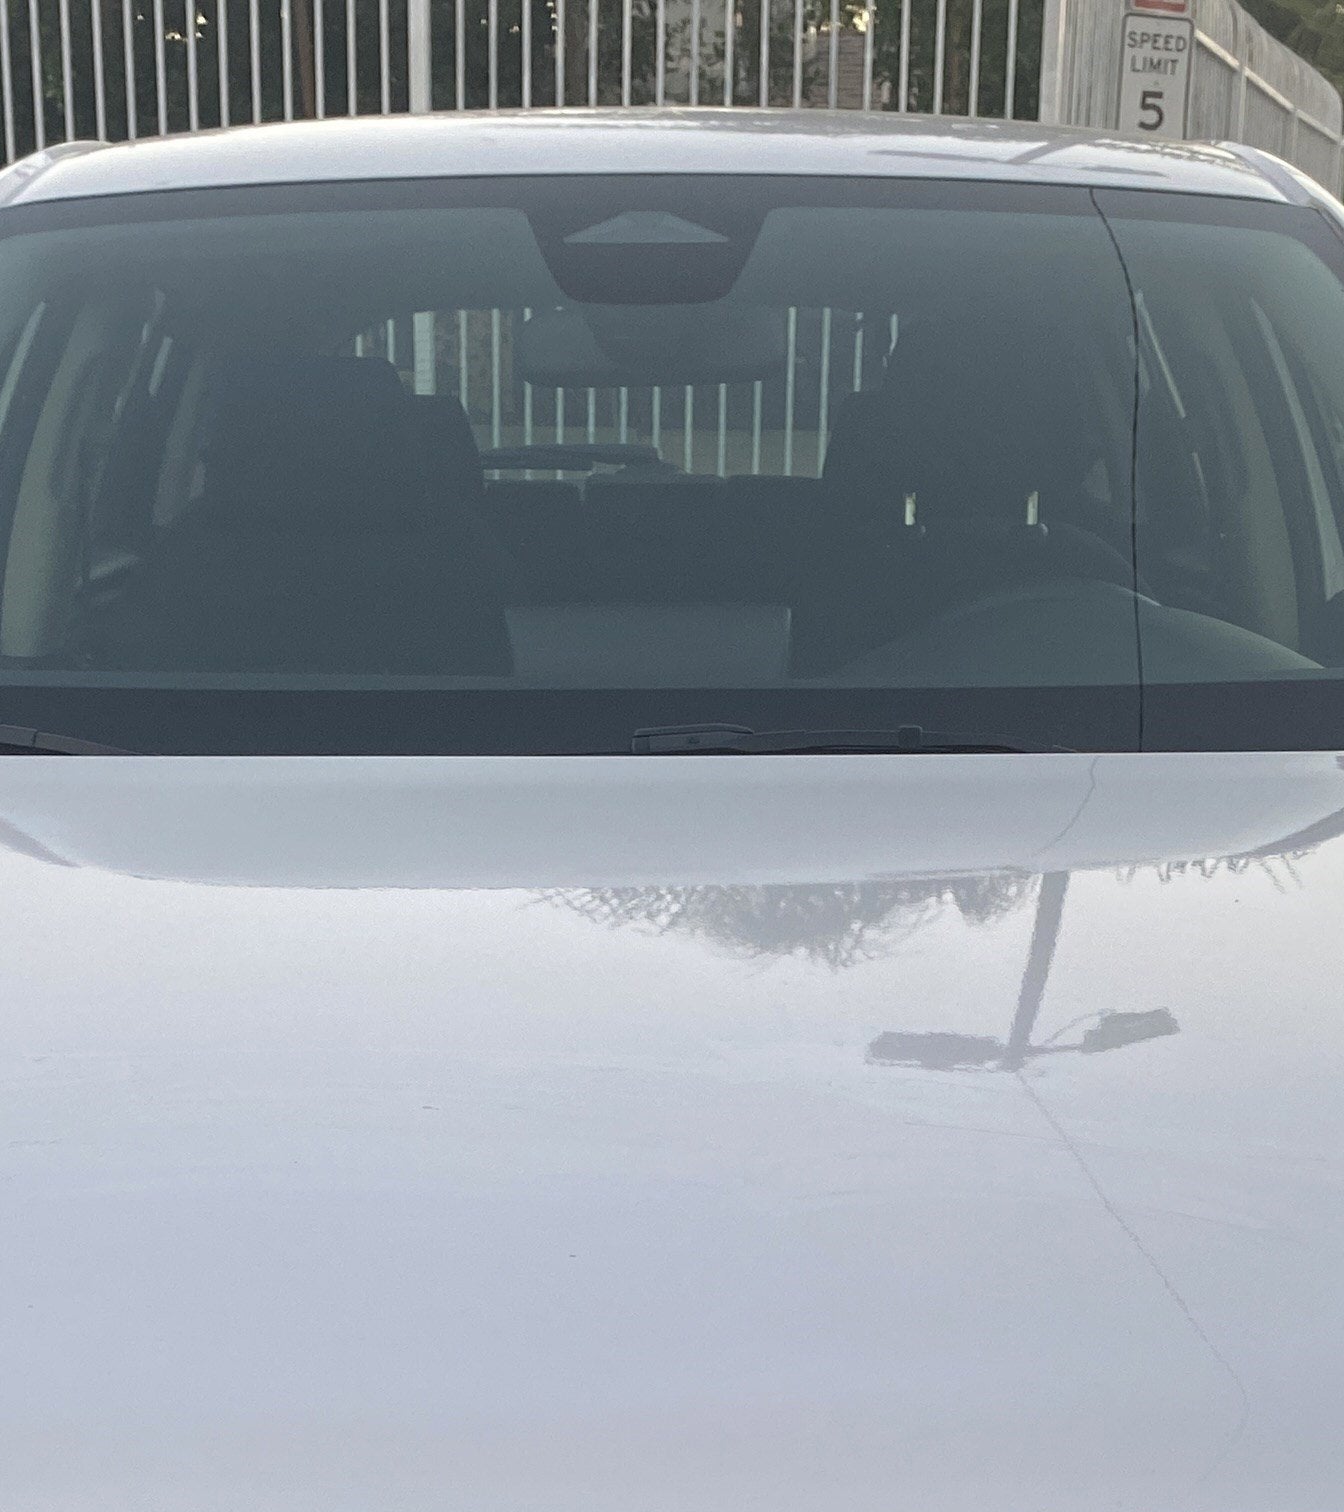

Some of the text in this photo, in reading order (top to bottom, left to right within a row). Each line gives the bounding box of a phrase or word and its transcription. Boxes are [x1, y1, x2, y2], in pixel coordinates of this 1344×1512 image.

[1127, 30, 1188, 52] SPEED
[1130, 55, 1179, 75] LIMIT
[1138, 90, 1164, 131] 5
